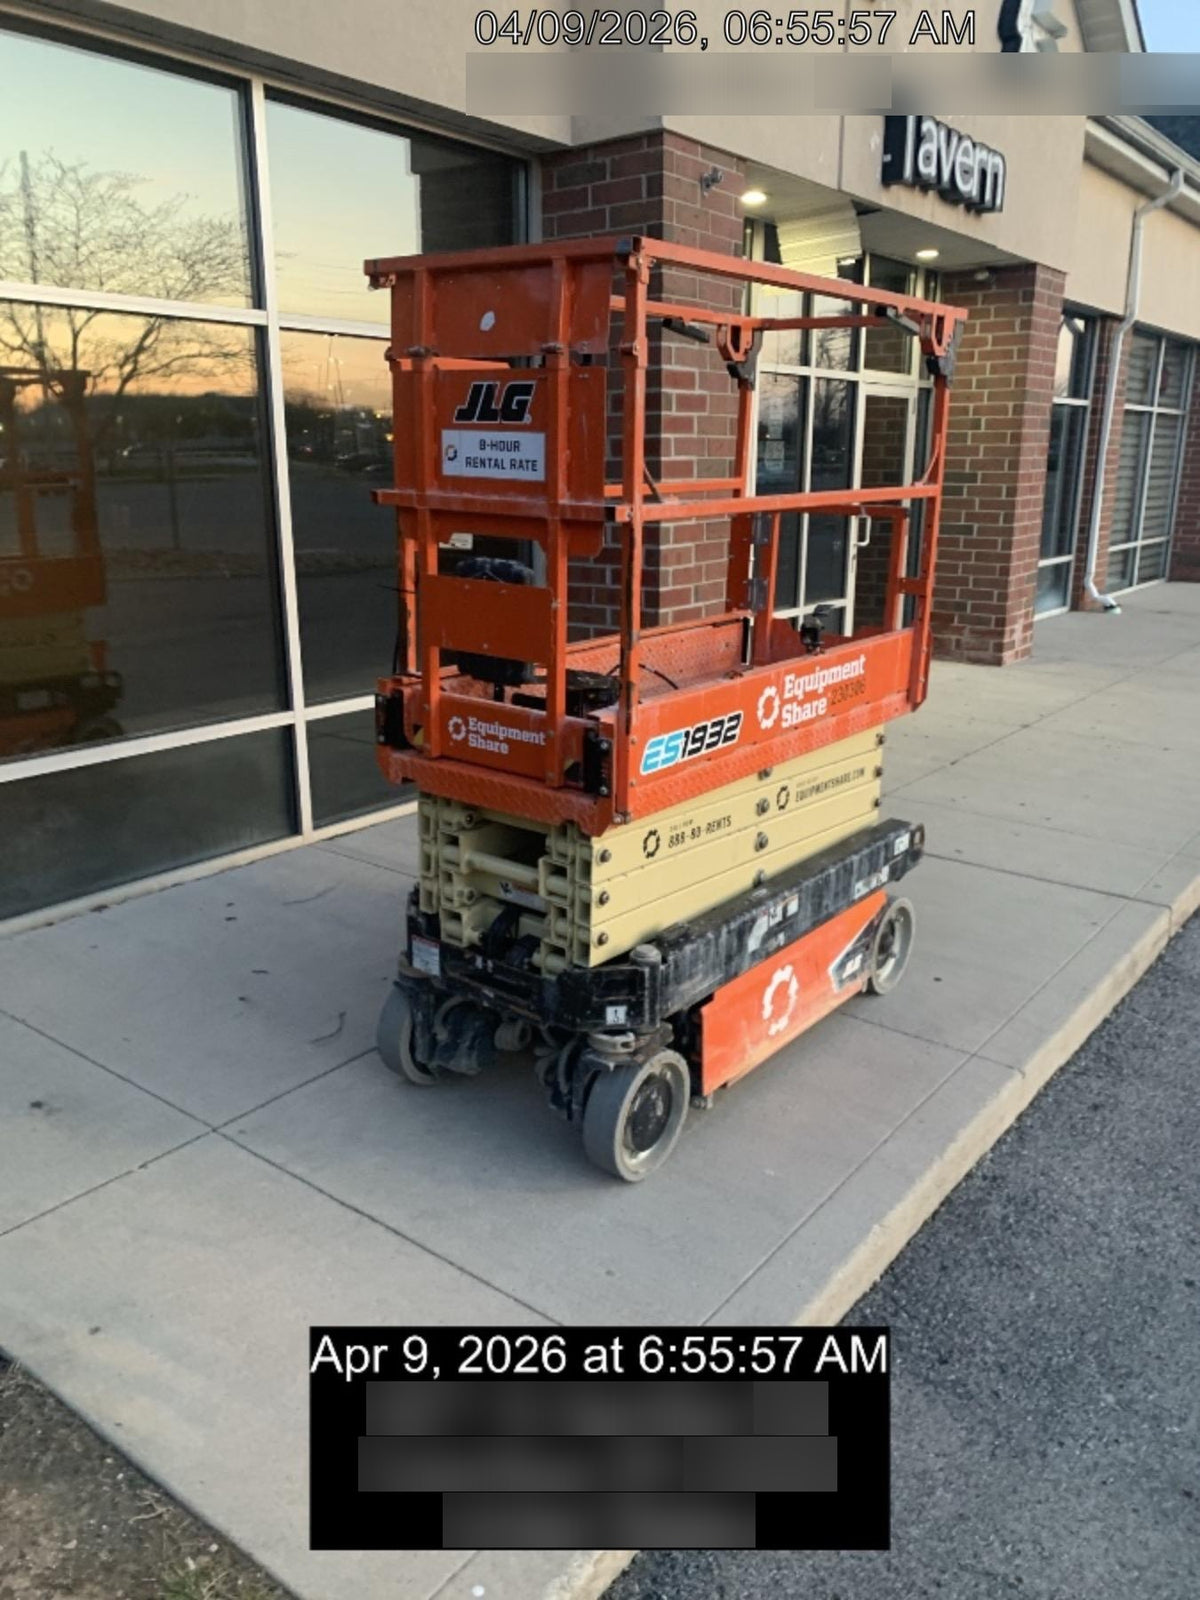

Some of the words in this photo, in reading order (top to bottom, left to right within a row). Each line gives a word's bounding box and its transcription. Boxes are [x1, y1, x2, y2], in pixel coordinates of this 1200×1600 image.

[453, 381, 536, 424] JLG
[479, 439, 521, 452] 8-HOUR
[465, 456, 506, 471] RENTAL
[509, 458, 538, 472] RATE
[782, 654, 867, 700] Equipment
[781, 697, 828, 728] Share
[468, 716, 546, 746] Equipment
[468, 734, 509, 754] Share
[640, 711, 744, 776] ES1932
